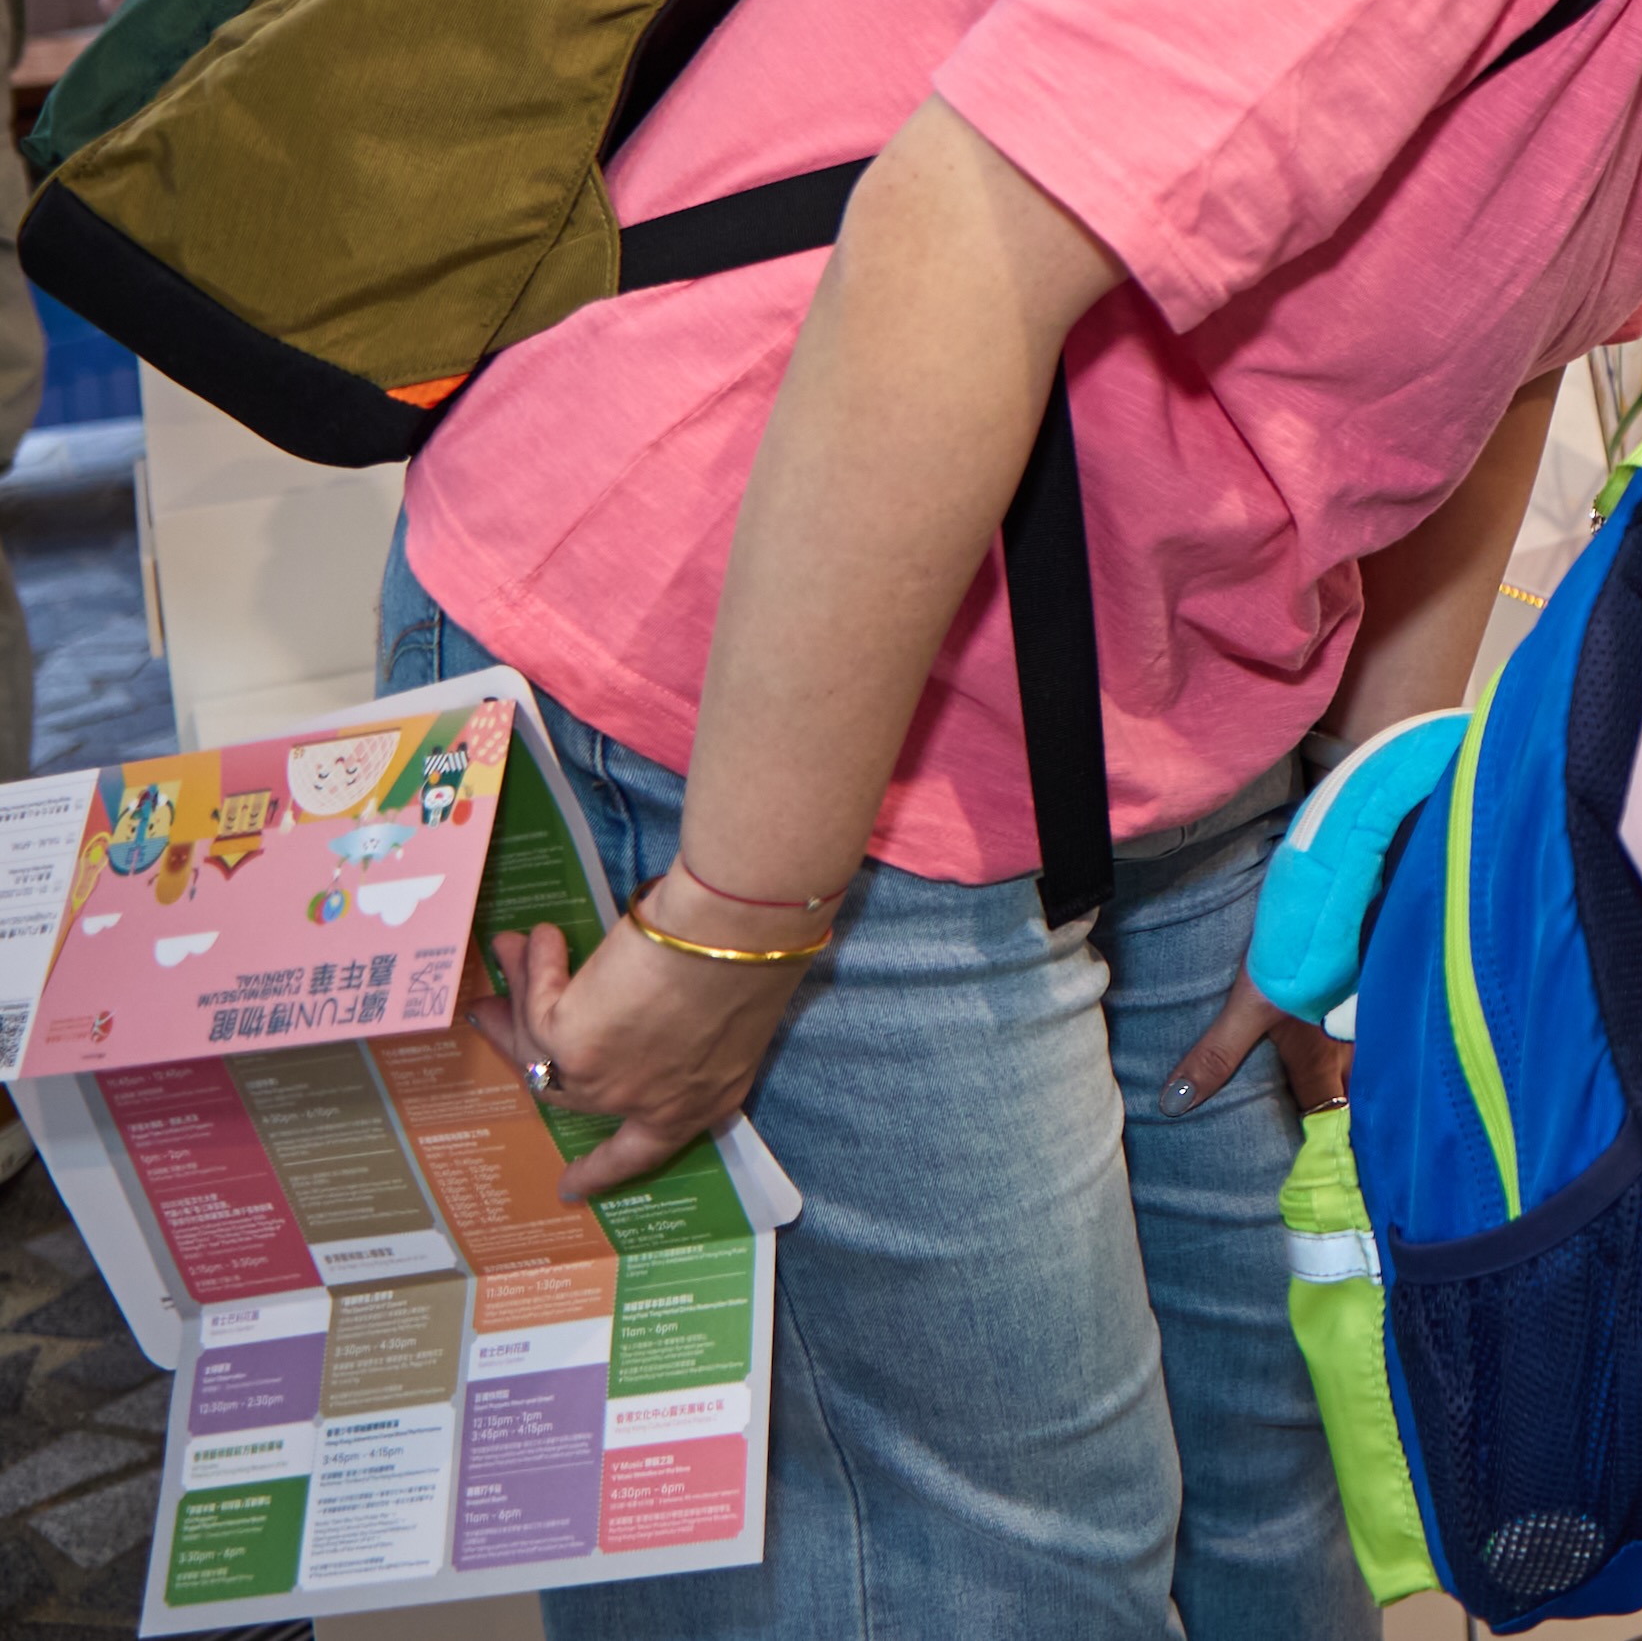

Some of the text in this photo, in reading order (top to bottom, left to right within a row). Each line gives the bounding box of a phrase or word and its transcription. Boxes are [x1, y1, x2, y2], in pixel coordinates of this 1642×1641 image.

[235, 967, 305, 990] CARNIVAL
[308, 952, 398, 996] 嘉年華
[197, 984, 302, 1008] FUN@MUSEUM
[208, 989, 391, 1043] 繽FUN博物館
[485, 1277, 573, 1299] 11:30am 1:30pm
[621, 1322, 679, 1340] 11am 6pm
[471, 1421, 554, 1442] 3:45pm 4:15pm
[473, 1411, 543, 1430] 12:15pm 1pm
[322, 1444, 405, 1466] 3:45pm 4:15pm
[610, 1482, 686, 1501] 4:30pm 6pm
[464, 1506, 522, 1525] 11am 6pm
